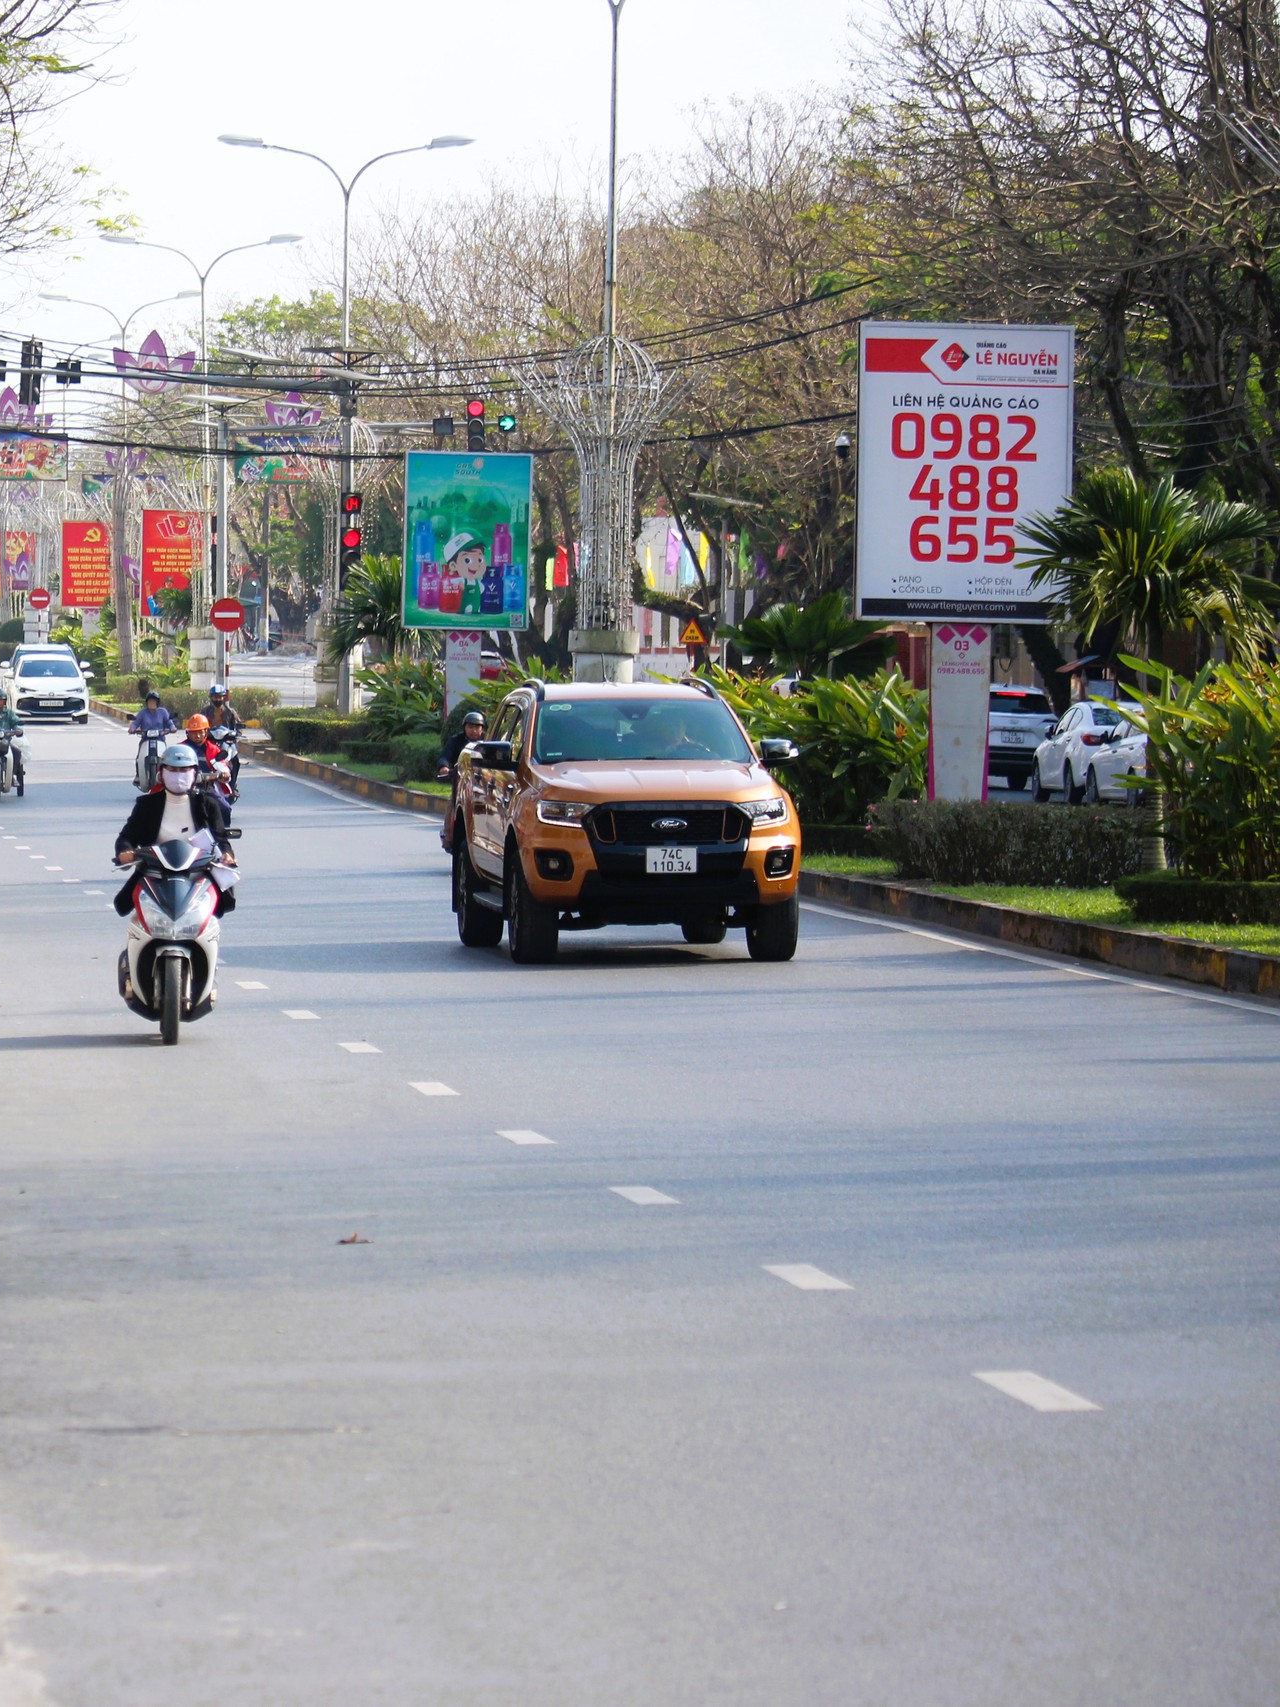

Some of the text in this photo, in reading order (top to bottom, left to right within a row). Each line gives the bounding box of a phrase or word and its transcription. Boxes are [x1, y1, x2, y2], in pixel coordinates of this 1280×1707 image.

[976, 350, 993, 365] LÊ
[997, 349, 1058, 366] NGUYỄN
[892, 393, 1040, 410] LIÊN HỆ QUẢNG CÁO
[891, 412, 1037, 462] 0982
[908, 464, 1019, 512] 488
[909, 515, 1015, 565] 655
[898, 576, 922, 584] PANO
[926, 586, 942, 594] LED
[1016, 589, 1032, 597] LED
[907, 601, 1017, 613] www.artlenguyen.com.vn
[954, 640, 969, 651] 03
[937, 667, 985, 675] 0982.488.655
[661, 849, 682, 860] 74C
[653, 861, 691, 872] 110.34
